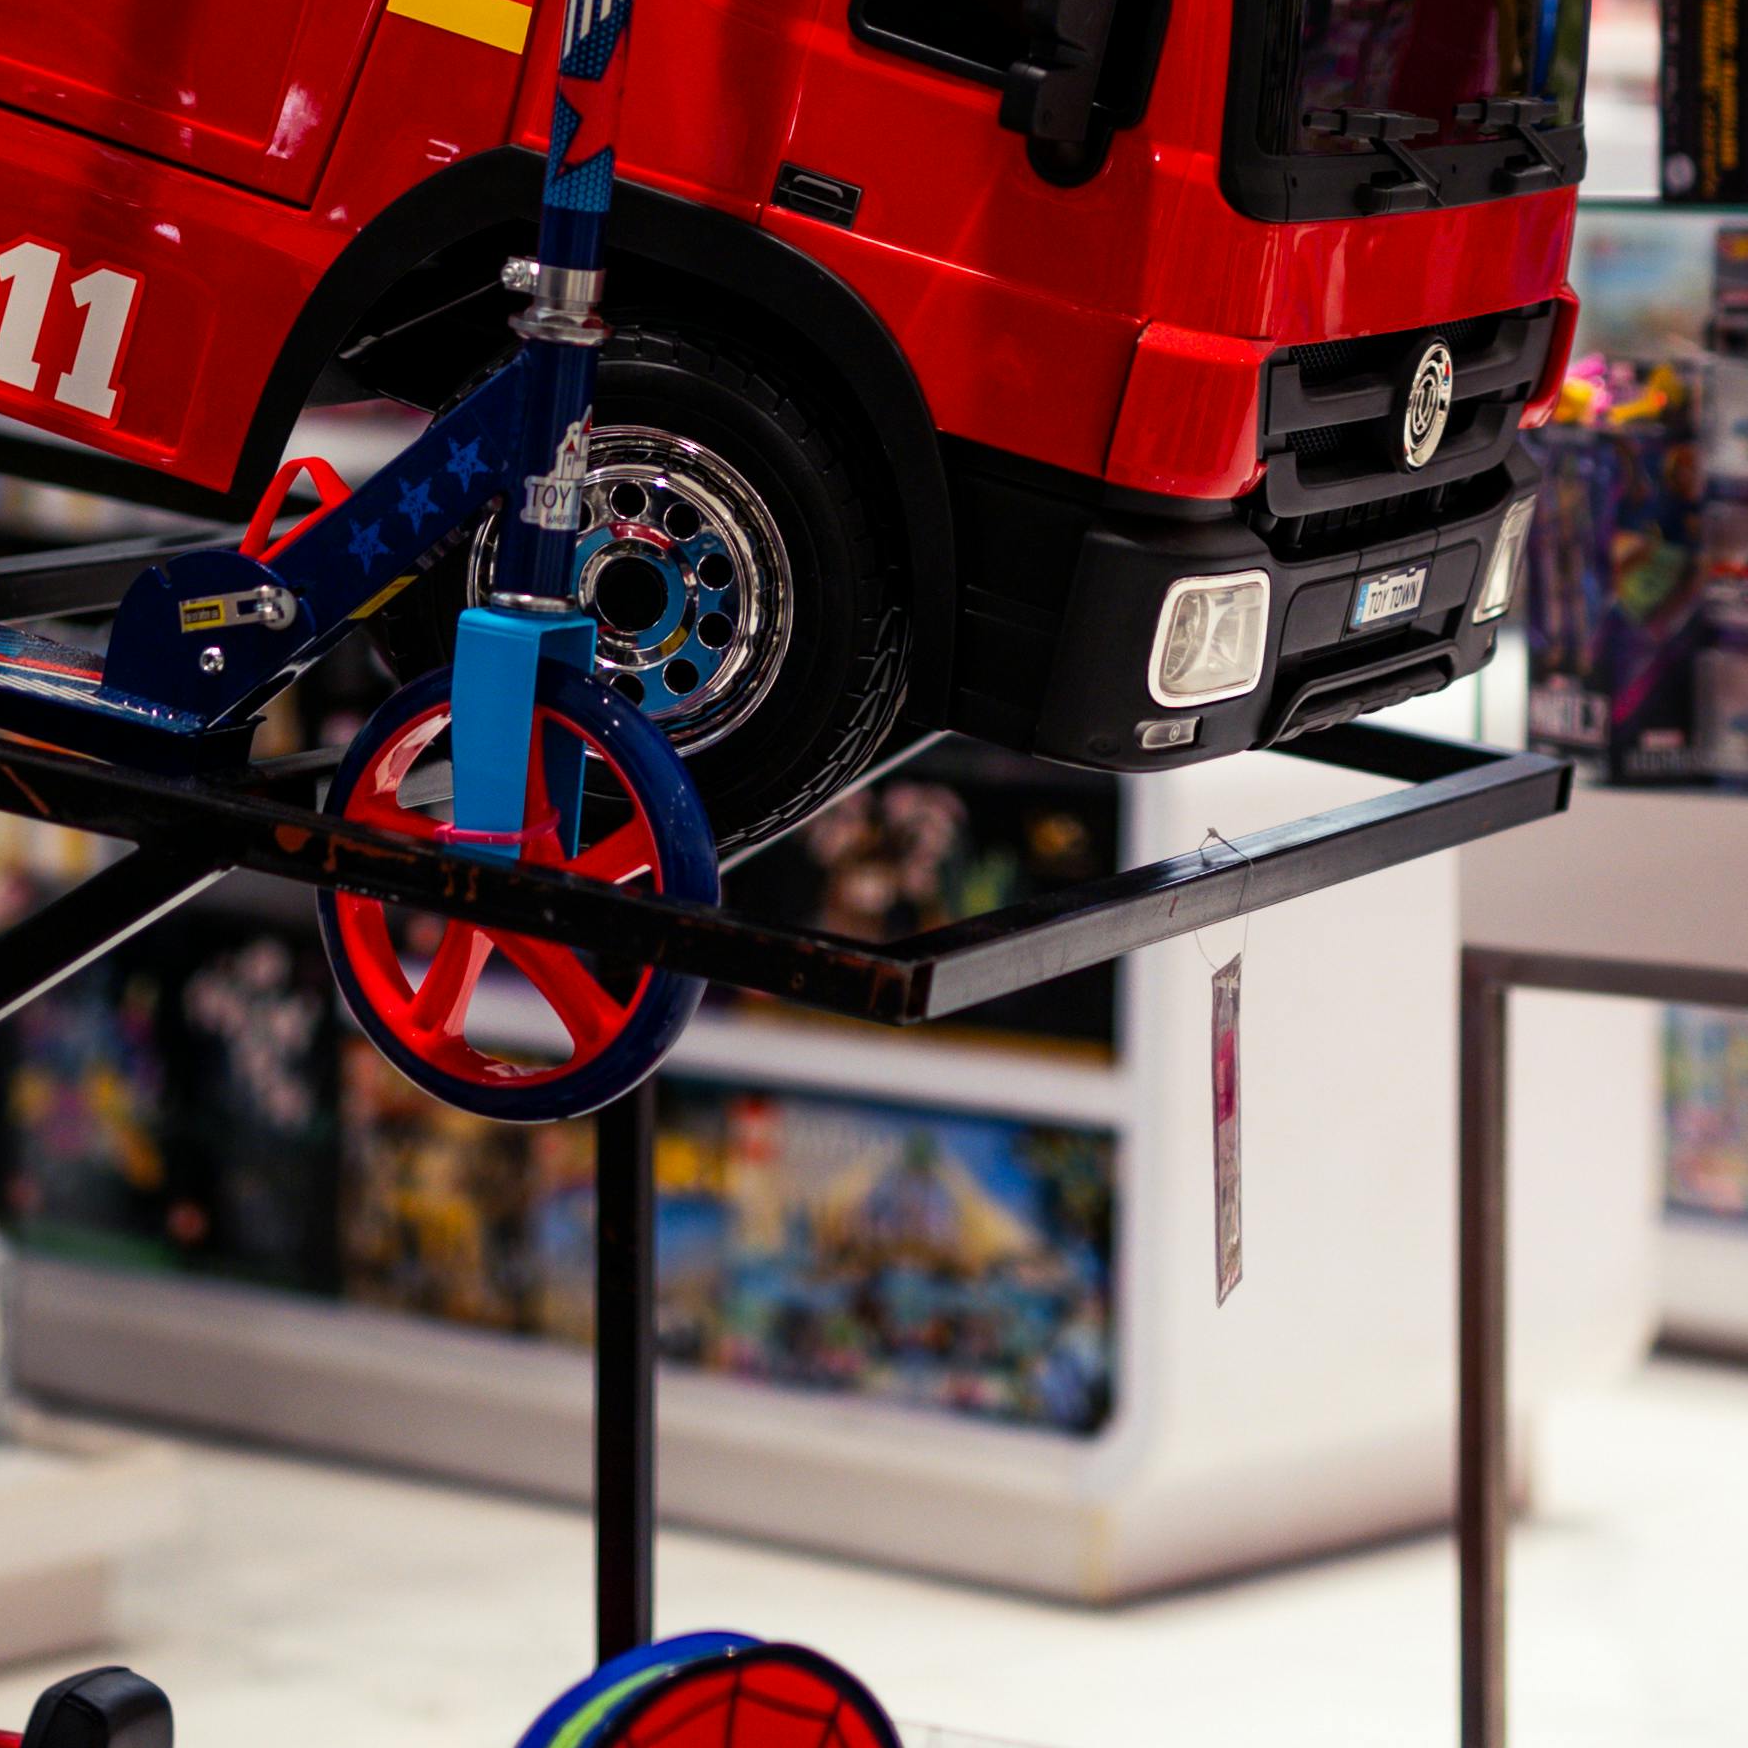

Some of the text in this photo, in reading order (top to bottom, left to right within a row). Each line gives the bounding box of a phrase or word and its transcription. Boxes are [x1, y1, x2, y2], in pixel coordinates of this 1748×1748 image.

[531, 483, 572, 510] TOY
[1368, 579, 1420, 617] TOY TOWN
